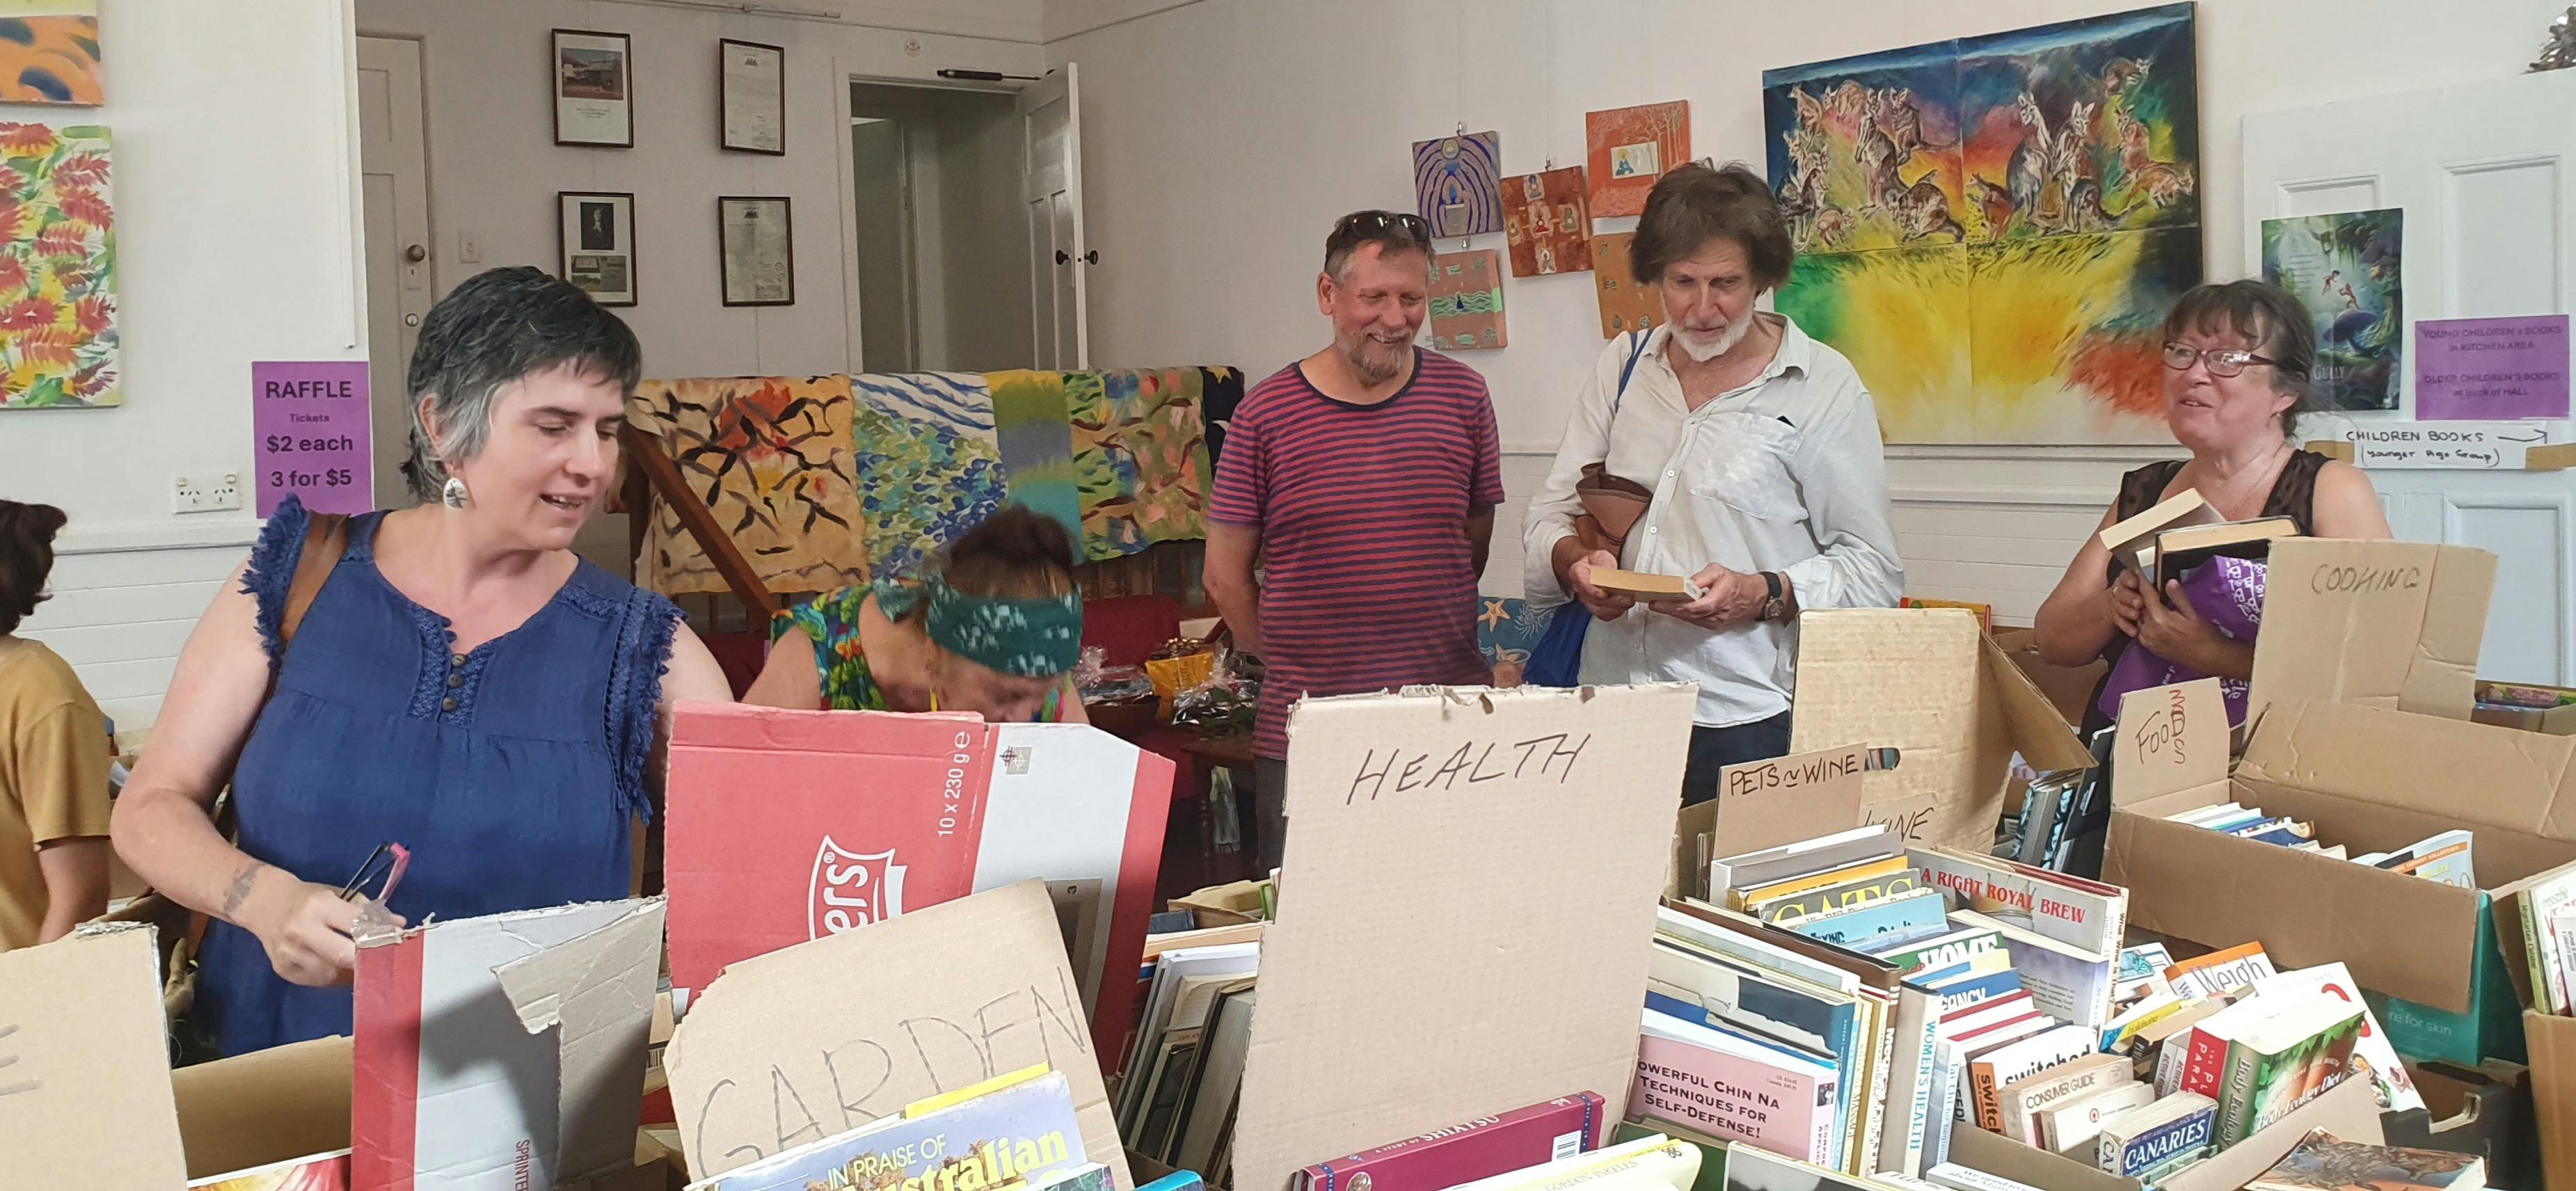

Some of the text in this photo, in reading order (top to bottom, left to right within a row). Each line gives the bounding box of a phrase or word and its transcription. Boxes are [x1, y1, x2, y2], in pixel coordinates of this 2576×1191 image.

[2423, 330, 2459, 339] YOUNG
[2525, 326, 2561, 335] BOOKS
[2460, 343, 2505, 351] KITCHEN
[265, 381, 352, 399] RAFFLE
[2424, 374, 2457, 383] OLDER
[2524, 371, 2561, 381] BOOKS
[2465, 388, 2488, 397] back
[2491, 387, 2501, 396] of
[2503, 387, 2529, 396] HALL
[289, 413, 330, 423] Tickets
[267, 435, 353, 454] $2 each
[2346, 431, 2484, 444] CHILDREN BOOKS
[2426, 449, 2449, 461] Age
[2454, 447, 2500, 468] Group)
[271, 469, 352, 487] 3 for $5
[2312, 563, 2420, 595] COOKING
[953, 753, 970, 763] g
[1346, 733, 1591, 806] HEALTH
[944, 768, 964, 799] 230
[1730, 763, 1780, 796] PETS
[1803, 753, 1859, 785] WINE
[944, 804, 958, 813] x
[937, 817, 955, 838] 10
[823, 864, 869, 935] ers
[1921, 868, 2086, 924] A RIGHT ROYAL BREW
[2189, 954, 2267, 993] Weigh
[2405, 1013, 2424, 1028] for
[2426, 1021, 2452, 1036] skin
[696, 966, 1086, 1178] GARDEN
[1949, 1063, 1958, 1079] Tai
[2200, 1071, 2213, 1089] PL
[2232, 1057, 2252, 1094] Body
[1637, 1061, 1781, 1110] OWERFUL CHIN NA
[1909, 1021, 1937, 1150] WOMEN'S HEALTH
[1946, 1084, 1956, 1104] Chi
[2026, 1080, 2069, 1110] CONSUMER
[2069, 1073, 2096, 1092] GUIDE
[1639, 1076, 1767, 1124] TECHNIQUES FOR
[1943, 1108, 1952, 1120] for
[1420, 1115, 1500, 1143] SHIATSU
[1644, 1093, 1761, 1139] SELF-DEFENSE!
[1847, 1093, 1861, 1142] MASSAGE
[2126, 1119, 2207, 1170] CANARIES
[827, 1133, 948, 1190] IN PRAISE OF
[841, 1128, 1070, 1191] stralian
